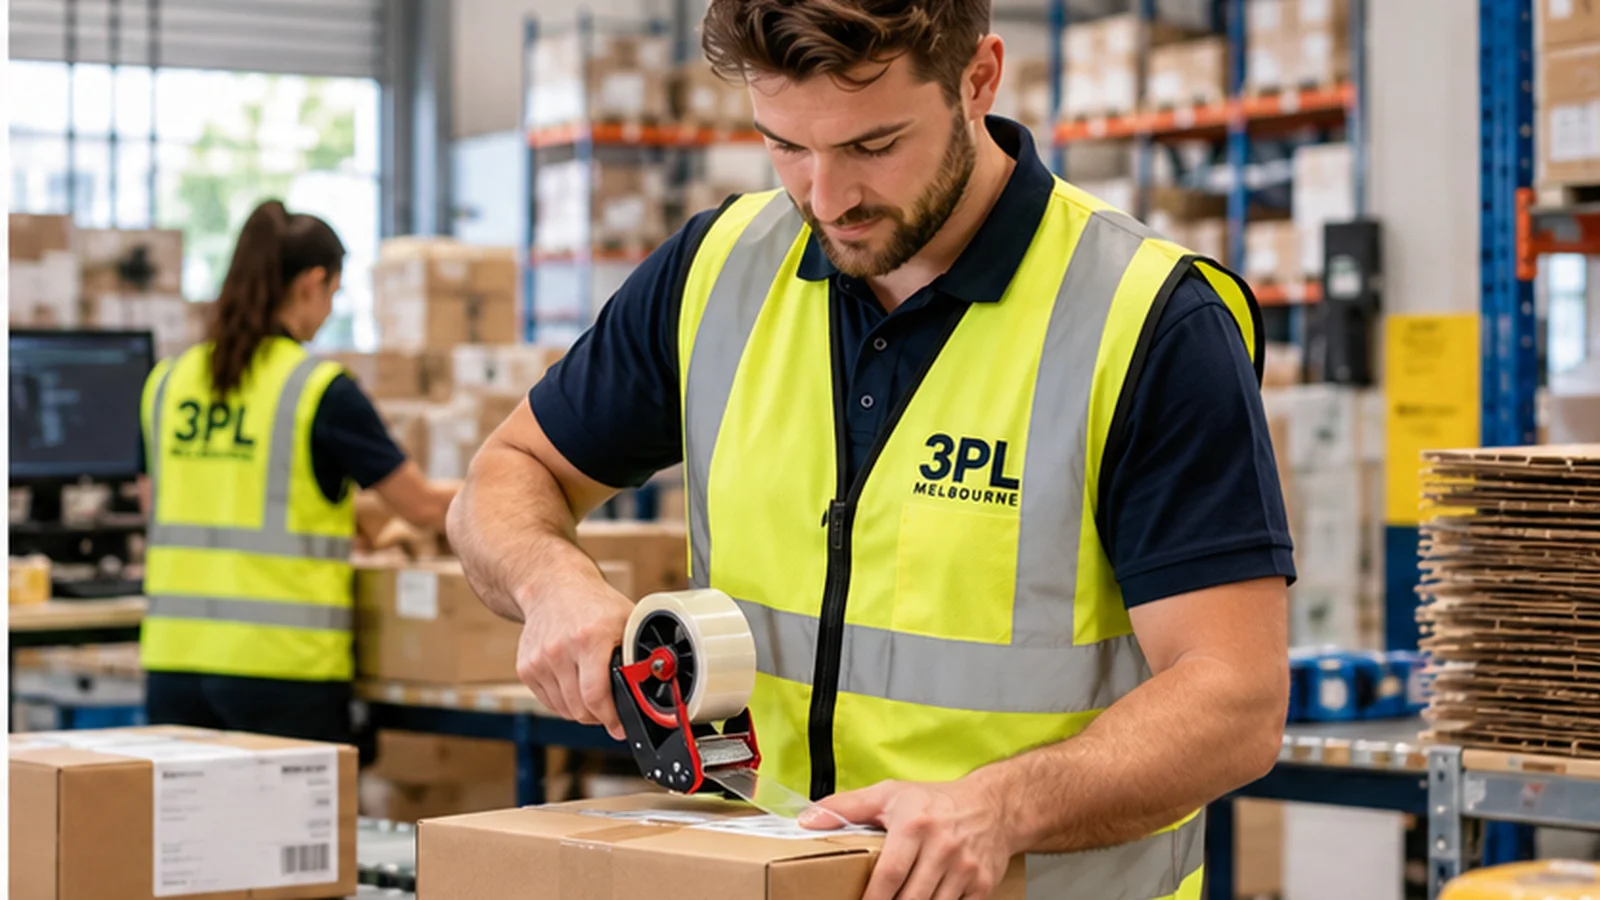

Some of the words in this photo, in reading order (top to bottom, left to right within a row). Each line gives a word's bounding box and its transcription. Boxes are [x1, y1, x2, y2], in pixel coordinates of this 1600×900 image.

[175, 400, 254, 446] 3PL
[919, 433, 1020, 490] 3PL
[913, 481, 1018, 507] MELBOURNE
